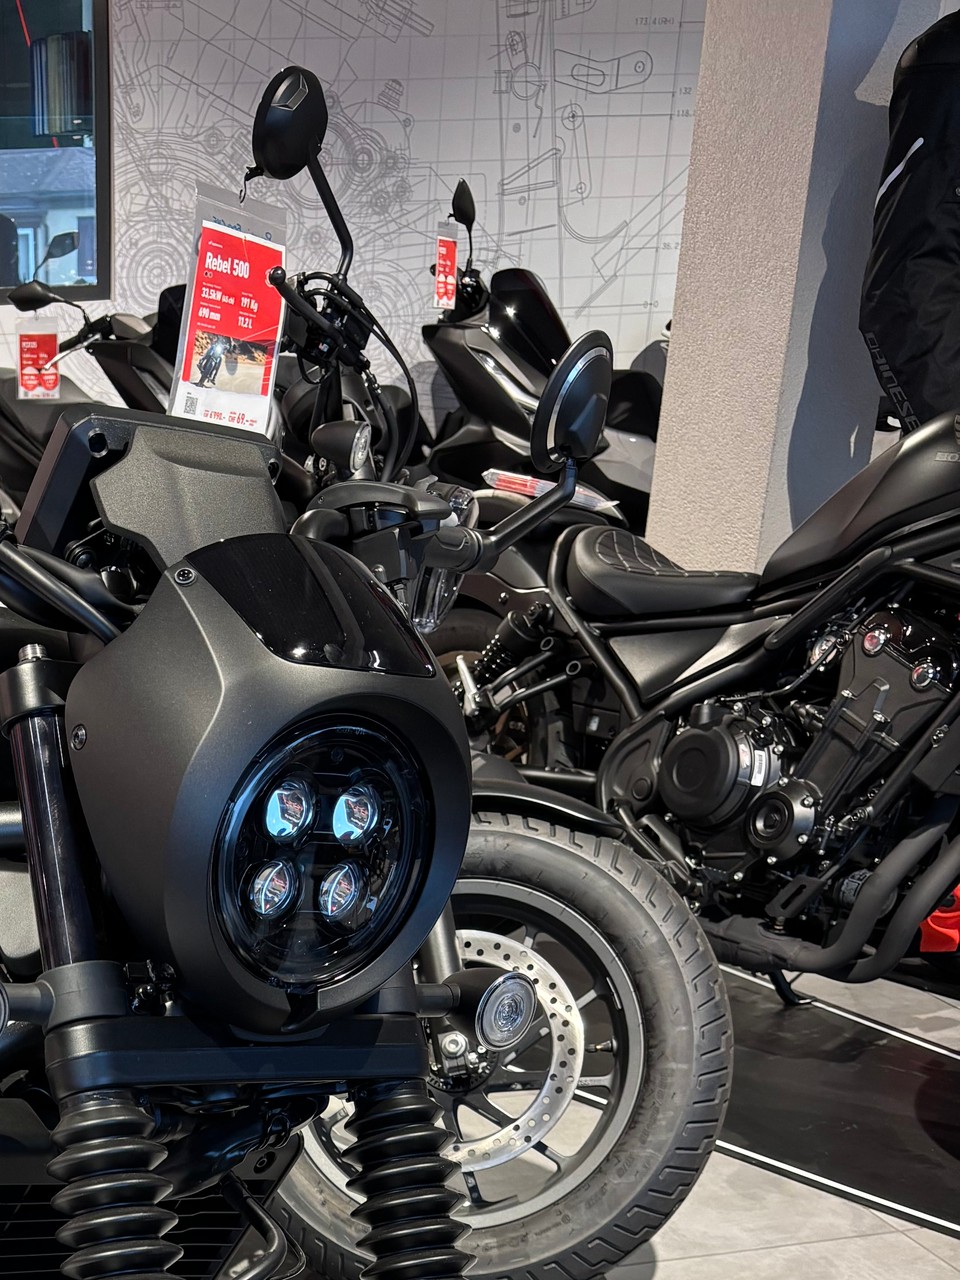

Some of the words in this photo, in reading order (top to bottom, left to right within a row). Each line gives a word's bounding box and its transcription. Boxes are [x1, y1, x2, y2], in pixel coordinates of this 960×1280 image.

[205, 251, 232, 274] Rebel
[233, 261, 250, 279] 500
[241, 297, 250, 309] 191
[250, 299, 258, 313] Kg
[198, 307, 210, 319] 690
[209, 312, 221, 321] mm
